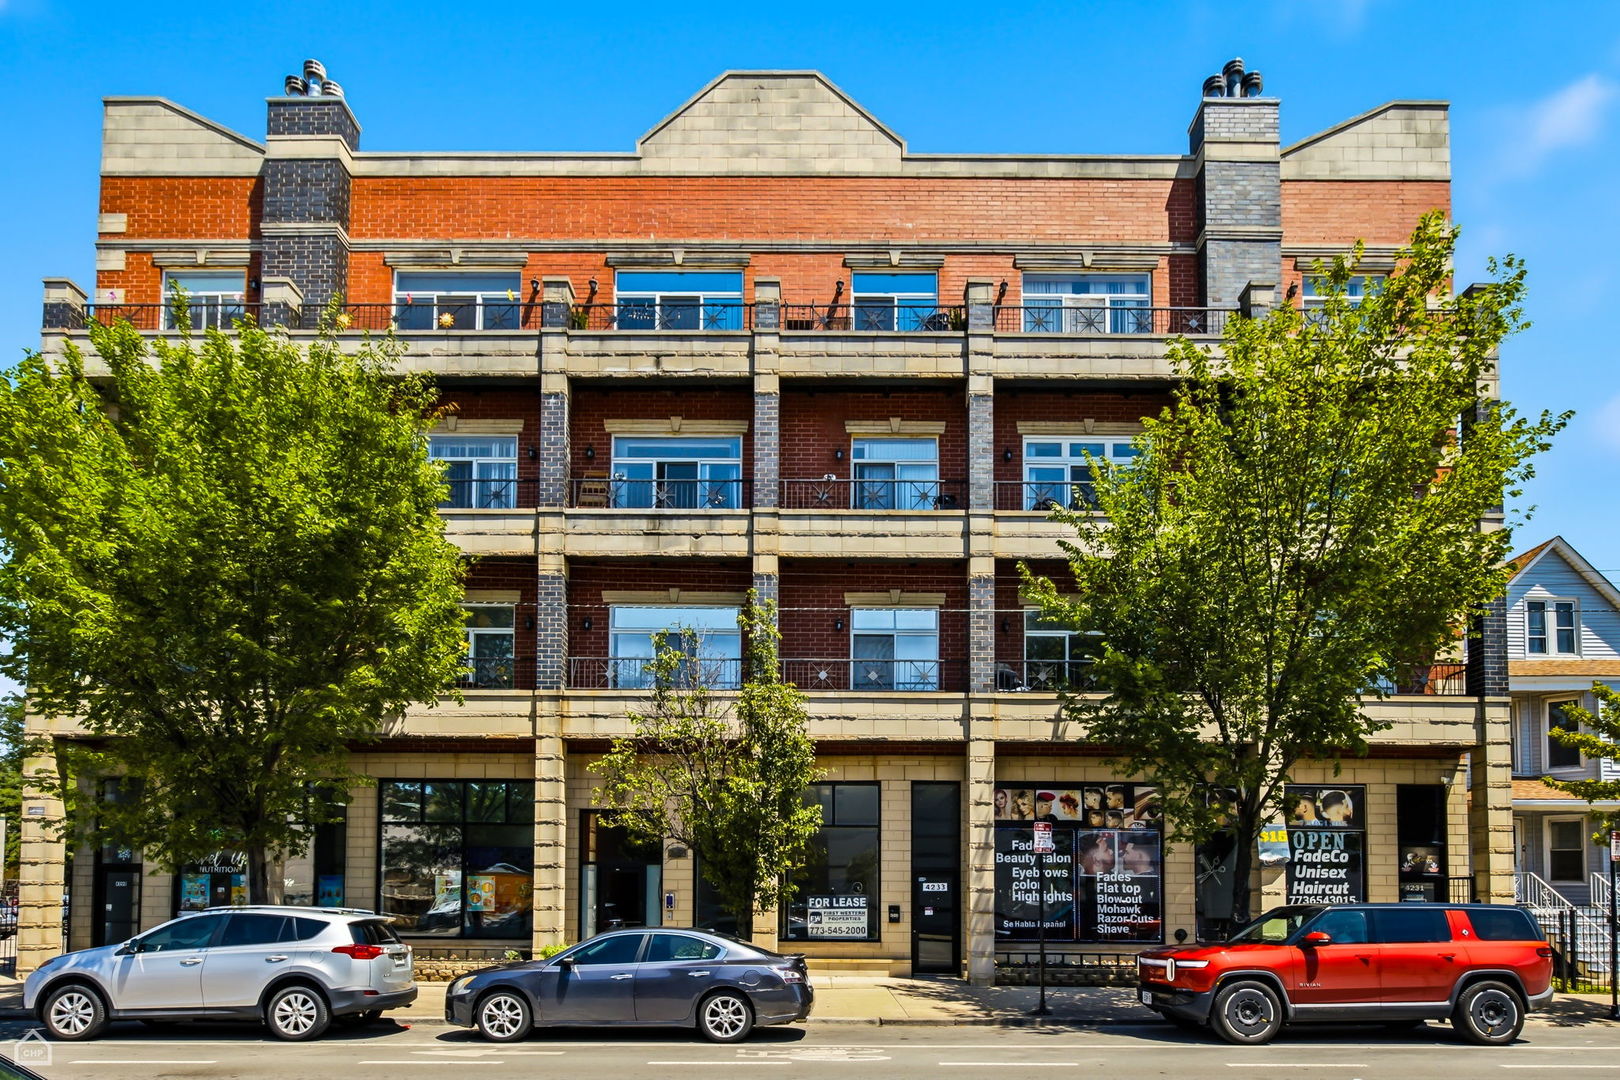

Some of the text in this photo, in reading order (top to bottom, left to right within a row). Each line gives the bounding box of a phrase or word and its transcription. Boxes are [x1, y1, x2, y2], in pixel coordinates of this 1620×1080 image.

[1259, 830, 1287, 843] $15
[1293, 832, 1345, 850] OPEN
[996, 853, 1037, 864] Beauty
[1294, 849, 1349, 863] FadeCo
[1012, 867, 1068, 880] Eyebows
[1096, 871, 1131, 882] Fades
[1295, 865, 1347, 879] Unisex
[1096, 883, 1141, 895] Flat top
[1292, 880, 1350, 895] Haircut
[809, 897, 867, 907] FOR LEASE
[1012, 890, 1073, 904] Highights
[1289, 895, 1357, 905] 7736543015
[1097, 904, 1141, 914] Mohawk
[810, 927, 866, 935] 773-545-2000
[1097, 924, 1130, 934] Shave
